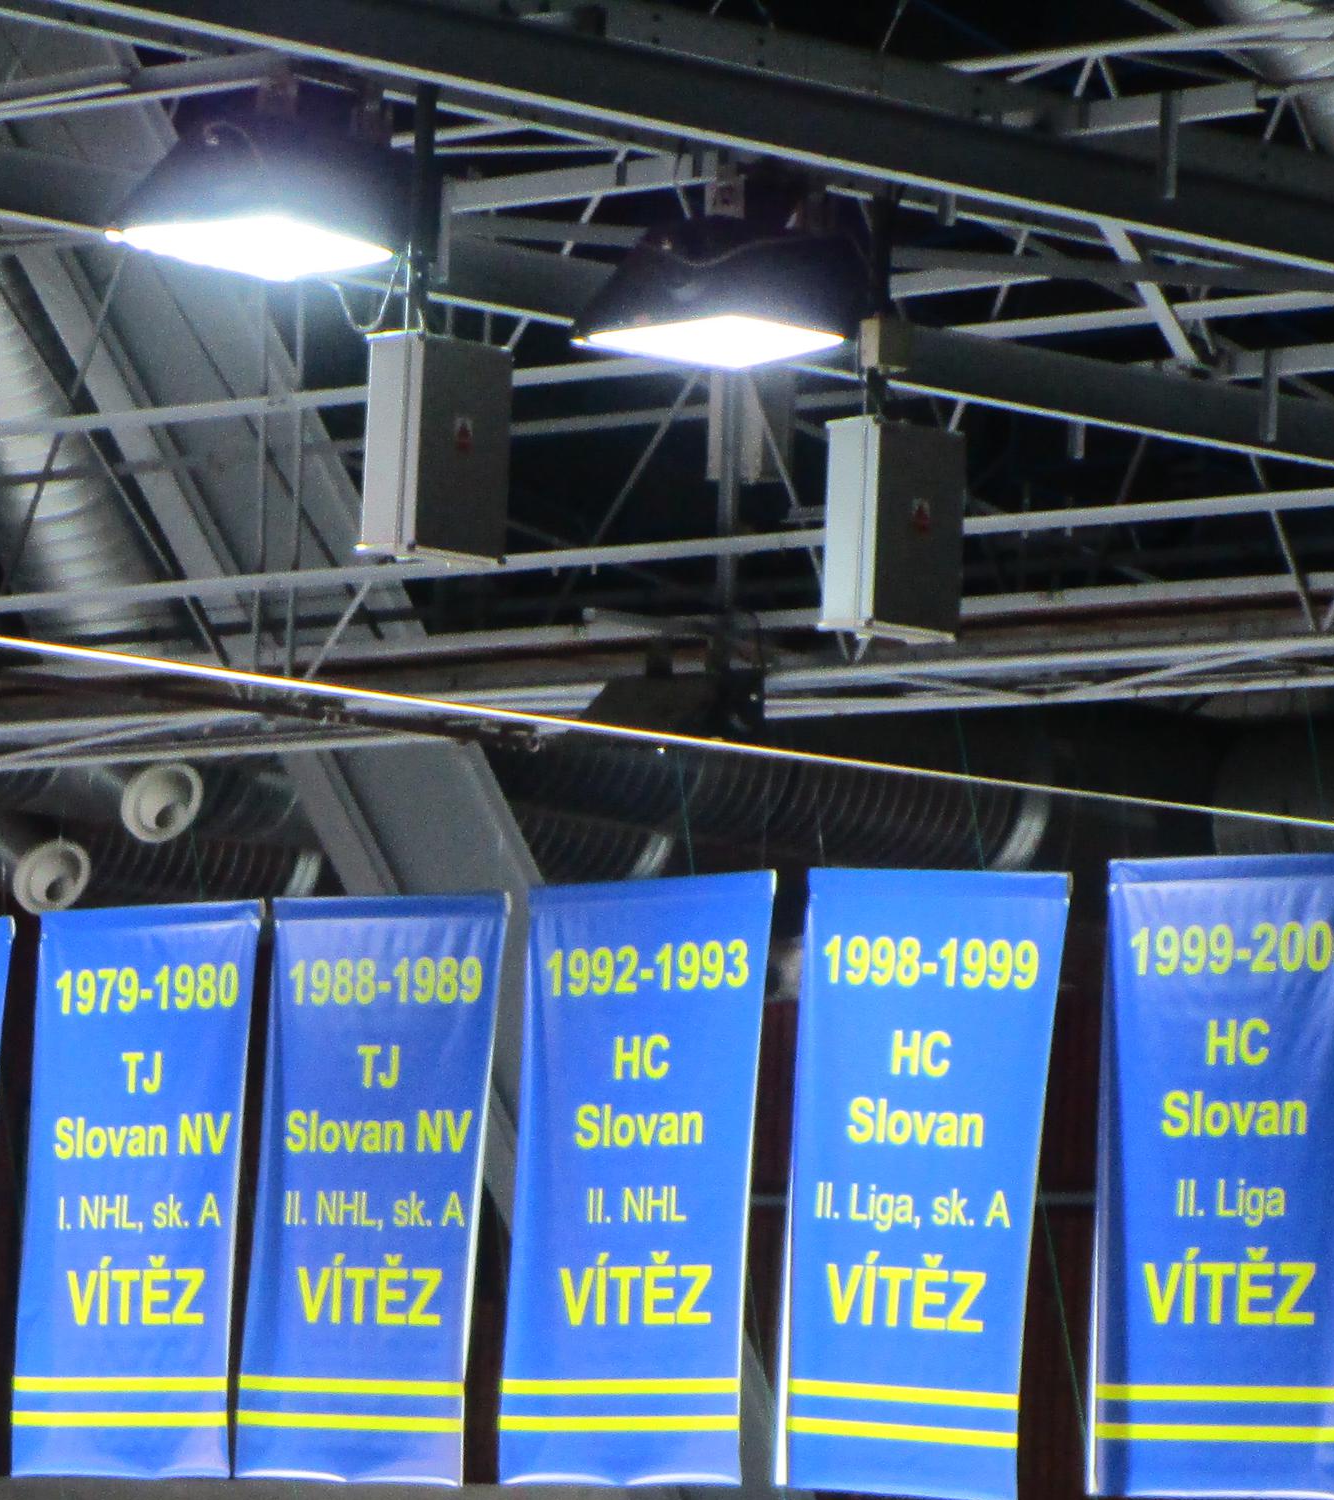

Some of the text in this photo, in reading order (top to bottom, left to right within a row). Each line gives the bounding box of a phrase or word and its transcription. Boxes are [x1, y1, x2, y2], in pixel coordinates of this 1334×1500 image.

[291, 956, 483, 1005] 1988-1989
[546, 939, 749, 996] 1992-1993
[825, 936, 1039, 989] 1998-1999
[56, 962, 239, 1014] 1979-1980
[614, 1034, 670, 1079] HC
[892, 1031, 951, 1077] HC
[1207, 1018, 1270, 1065] HC
[122, 1052, 163, 1094] TJ
[358, 1045, 400, 1088] TJ
[55, 1113, 231, 1160] Slovan NV
[286, 1110, 472, 1153] Slovan NV
[575, 1104, 703, 1149] Slovan
[848, 1097, 984, 1147] Slovan
[1162, 1091, 1307, 1137] Slovan
[79, 1195, 144, 1231] NHL,
[153, 1194, 190, 1229] sk.
[198, 1193, 222, 1226] A
[316, 1191, 384, 1229] NHL,
[393, 1192, 432, 1227] sk.
[441, 1192, 466, 1227] A
[622, 1186, 687, 1222] NHL
[849, 1184, 921, 1232] Liga,
[932, 1189, 975, 1226] sk.
[985, 1191, 1011, 1228] A
[1217, 1179, 1286, 1227] Liga
[68, 1256, 205, 1325] VÍTĚZ
[298, 1254, 442, 1326] VÍTĚZ
[560, 1252, 712, 1326] VÍTĚZ
[827, 1251, 986, 1332] VÍTĚZ
[1144, 1248, 1316, 1325] VÍTĚZ
